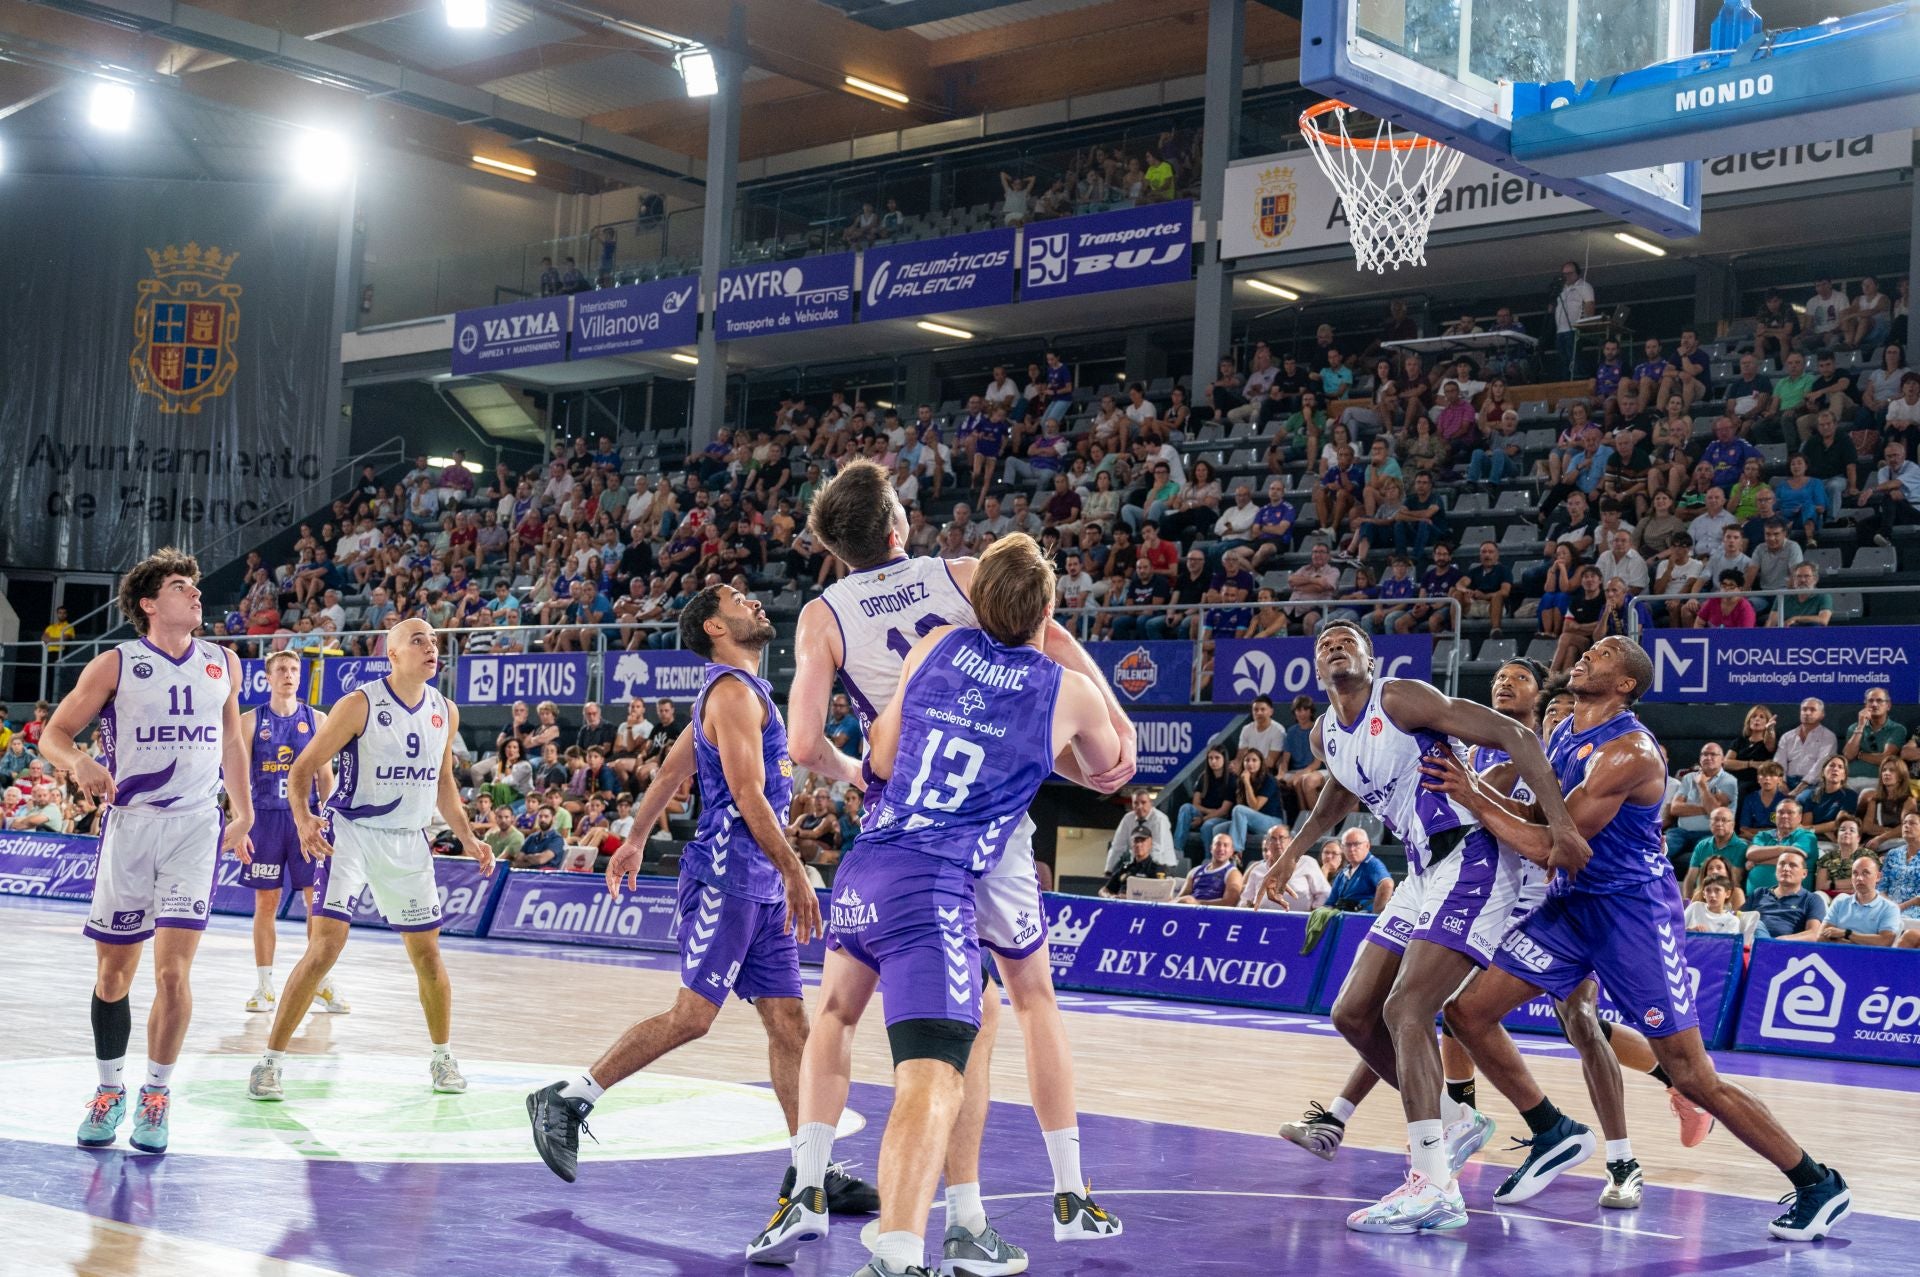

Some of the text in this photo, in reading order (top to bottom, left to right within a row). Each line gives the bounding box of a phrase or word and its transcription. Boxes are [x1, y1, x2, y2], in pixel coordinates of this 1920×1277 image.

[1675, 74, 1774, 112] MONDO
[1078, 222, 1182, 248] Transportes
[896, 250, 1010, 280] NEUMÁTICOS
[1072, 243, 1186, 276] BUJ
[795, 289, 849, 307] Trans
[888, 273, 976, 299] PALENCIA
[580, 299, 628, 314] Interiorismo
[483, 311, 560, 341] VAYMA
[580, 312, 660, 339] Villanova
[727, 316, 775, 332] Transporte
[778, 313, 791, 326] de
[479, 341, 560, 360] LIMPIEZA Y MANTENIMIENTO
[27, 434, 320, 480] Ayuntamiento
[46, 484, 294, 527] de Palencia
[859, 582, 931, 618] ORDOÑEZ
[365, 660, 393, 673] AMBUL
[1717, 647, 1909, 666] MORALESCERVERA
[503, 661, 577, 697] PETKUS
[1117, 668, 1156, 681] PALENCIA
[1729, 671, 1890, 686] Implantología Dental Inmediata
[168, 685, 194, 715] 11
[135, 725, 217, 743] UEMC
[926, 706, 1007, 738] recoletas salud
[406, 732, 420, 758] 9
[262, 763, 292, 773] agro
[375, 765, 437, 781] UEMC
[905, 728, 986, 812] 13
[251, 863, 281, 878] gaza
[514, 889, 643, 936] Familia
[649, 906, 675, 915] ahorro
[1442, 915, 1466, 931] CBC
[1012, 923, 1038, 945] CRZA
[1128, 917, 1271, 945] HOTEL
[1051, 951, 1077, 963] NCHO
[1501, 928, 1554, 971] gaza
[1095, 948, 1288, 989] REY SANCHO
[1857, 985, 1920, 1031] ép
[1853, 1029, 1912, 1043] SOLUCIONES
